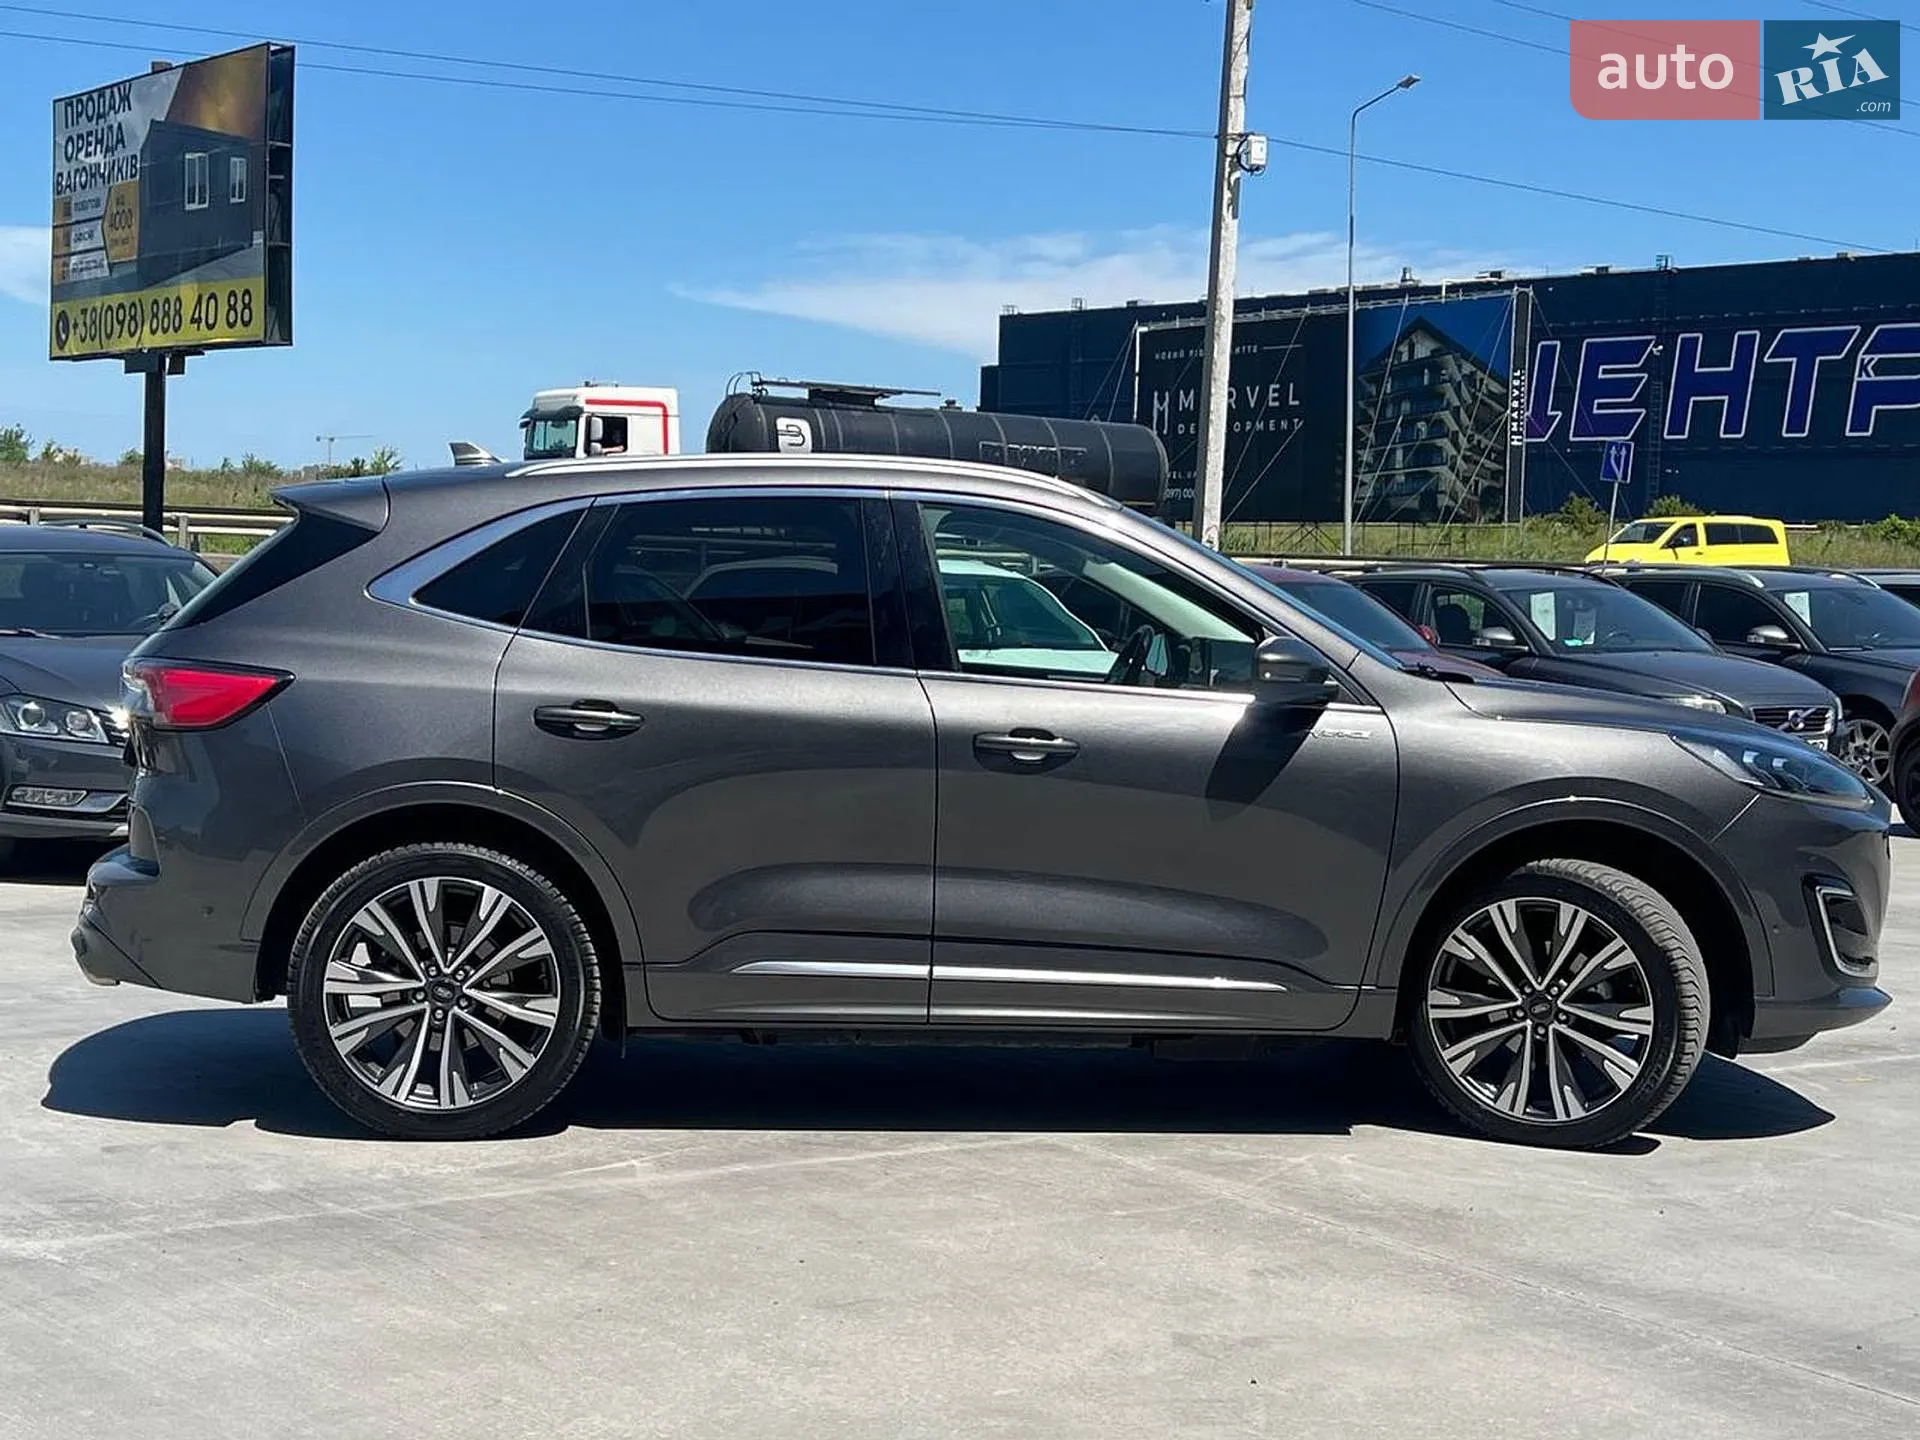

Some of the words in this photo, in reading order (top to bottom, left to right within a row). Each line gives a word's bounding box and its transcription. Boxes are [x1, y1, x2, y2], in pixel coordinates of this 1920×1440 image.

[64, 82, 132, 129] ПРОДАЖ
[64, 121, 126, 163] ОРЕНДА
[56, 154, 138, 195] ВАГОНЧИКІВ
[72, 298, 146, 350] +38(098)
[150, 296, 182, 336] 888
[190, 292, 219, 331] 40
[226, 288, 253, 329] 88
[1179, 382, 1300, 412] MRVEL
